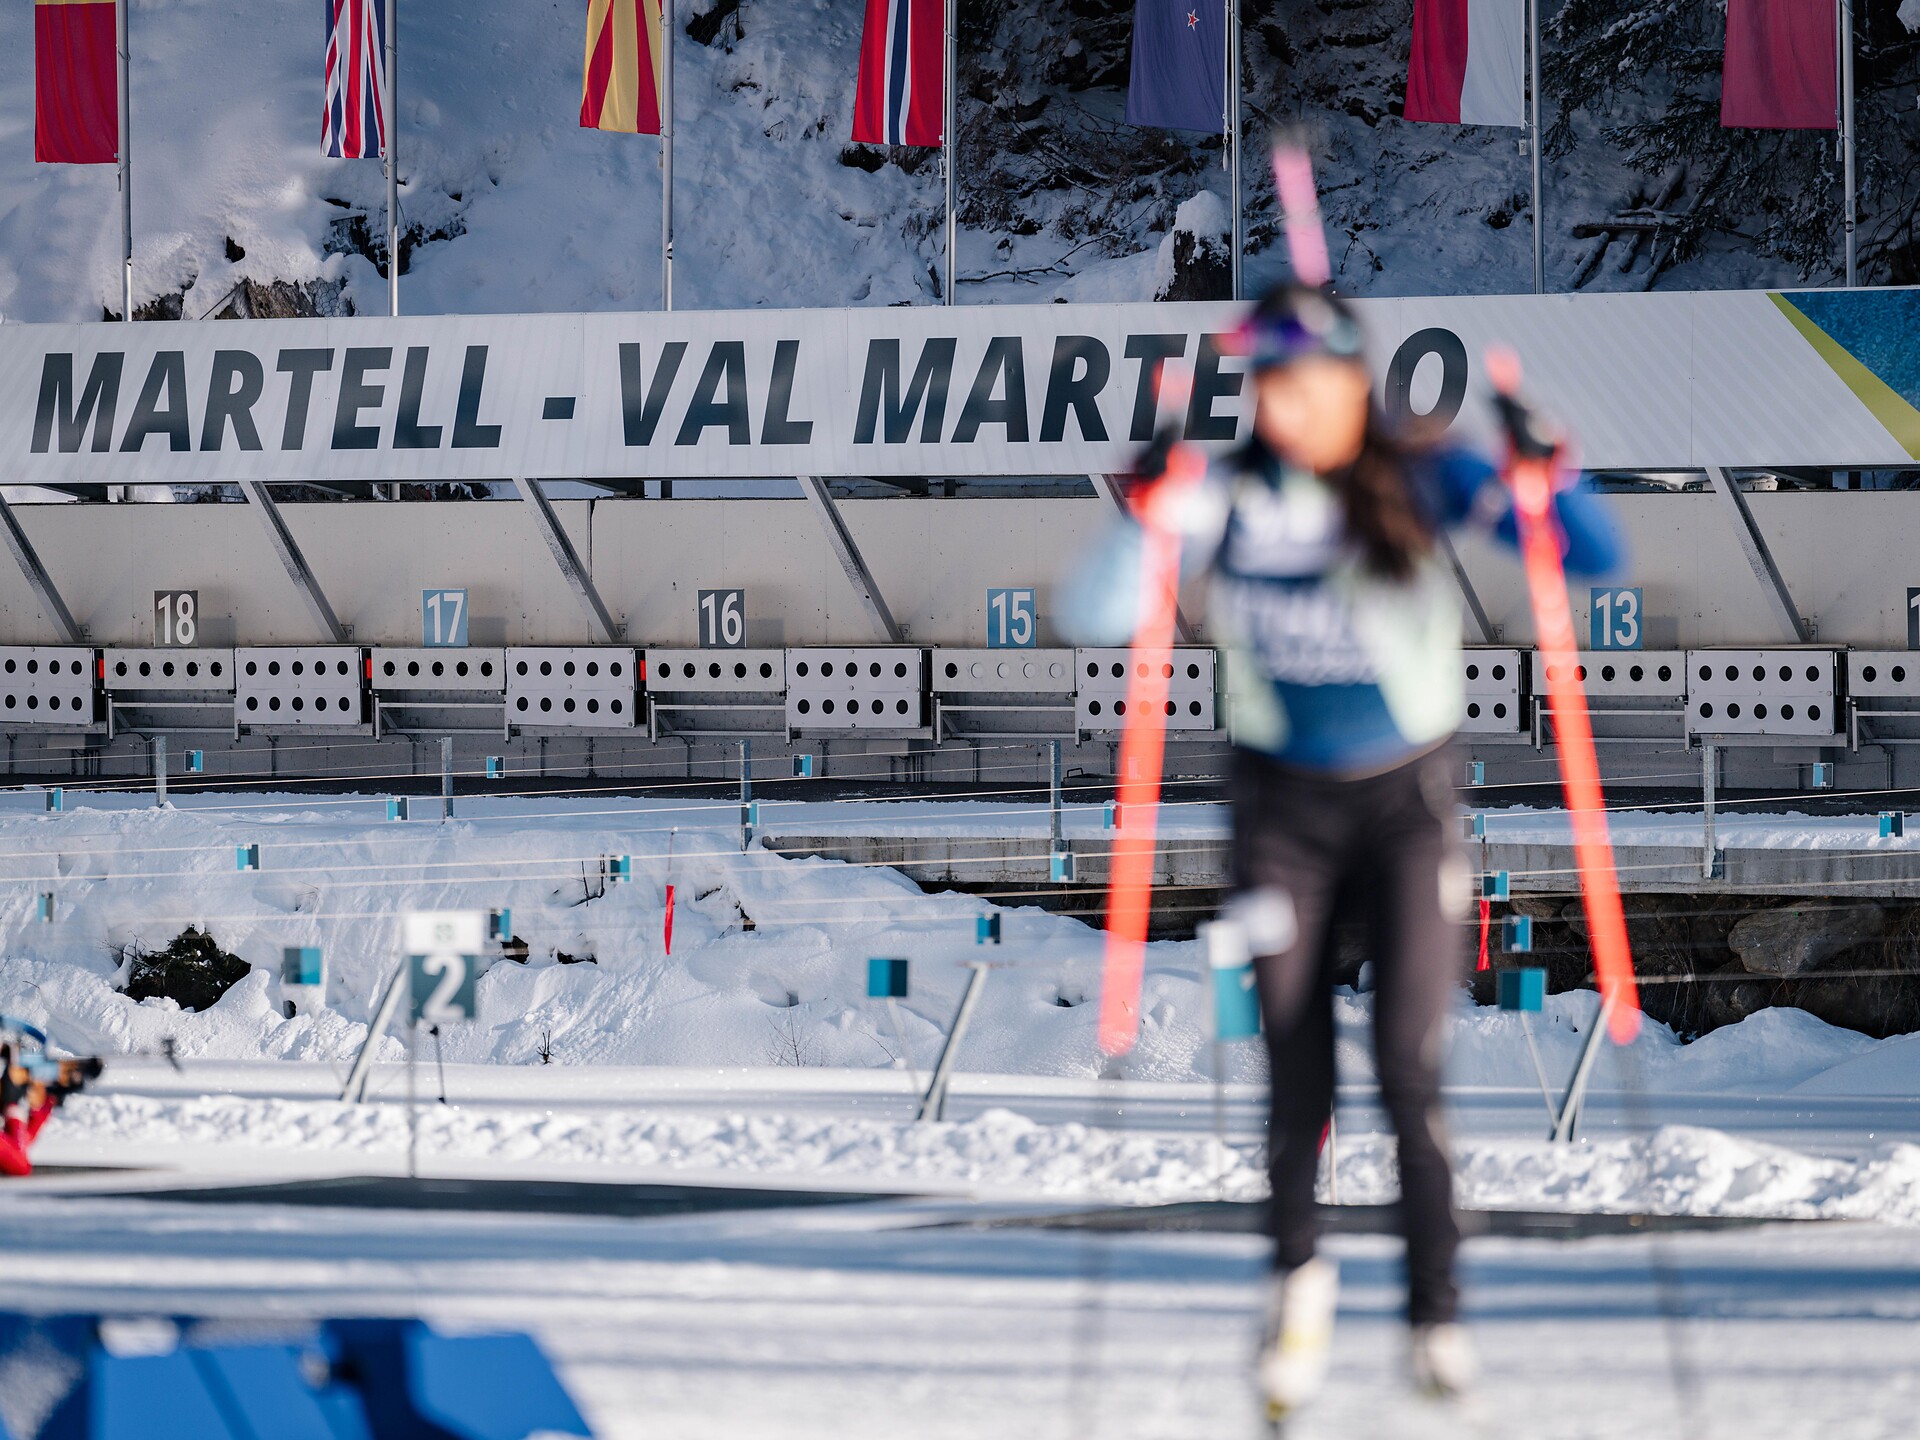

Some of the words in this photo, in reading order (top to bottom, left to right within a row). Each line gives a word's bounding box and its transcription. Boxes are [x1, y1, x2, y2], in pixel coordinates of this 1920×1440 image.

[31, 345, 502, 454] MARTELL
[541, 396, 577, 420] -
[618, 339, 814, 447] VAL
[852, 326, 1469, 446] MARTEO
[157, 593, 195, 645] 18
[425, 591, 465, 644] 17
[701, 592, 744, 645] 16
[990, 590, 1034, 645] 15
[1595, 590, 1639, 647] 13
[422, 954, 467, 1021] 2
